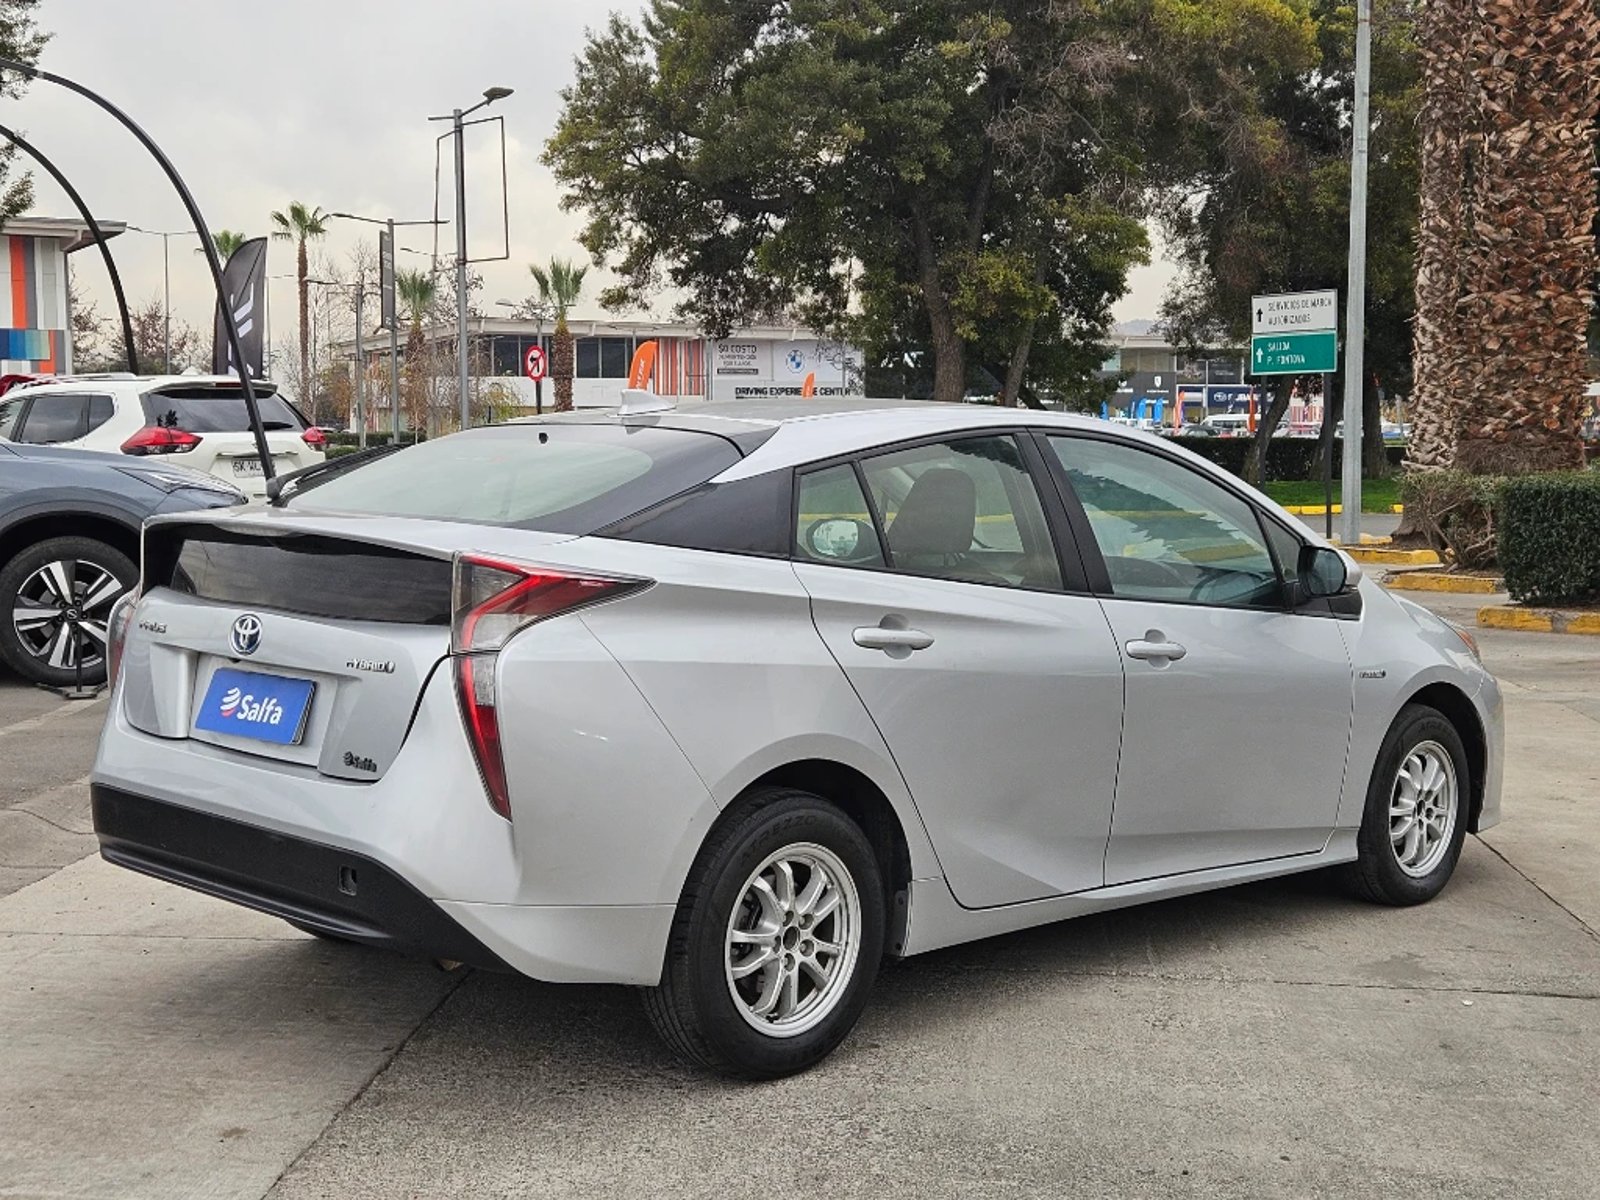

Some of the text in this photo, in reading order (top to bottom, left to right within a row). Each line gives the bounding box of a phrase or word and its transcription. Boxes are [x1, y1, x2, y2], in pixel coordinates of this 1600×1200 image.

[730, 344, 757, 353] COSTO
[1267, 341, 1291, 352] SALIDA
[735, 387, 768, 396] DRIVING
[769, 387, 818, 396] EXPERIEE
[237, 694, 284, 726] Salfa
